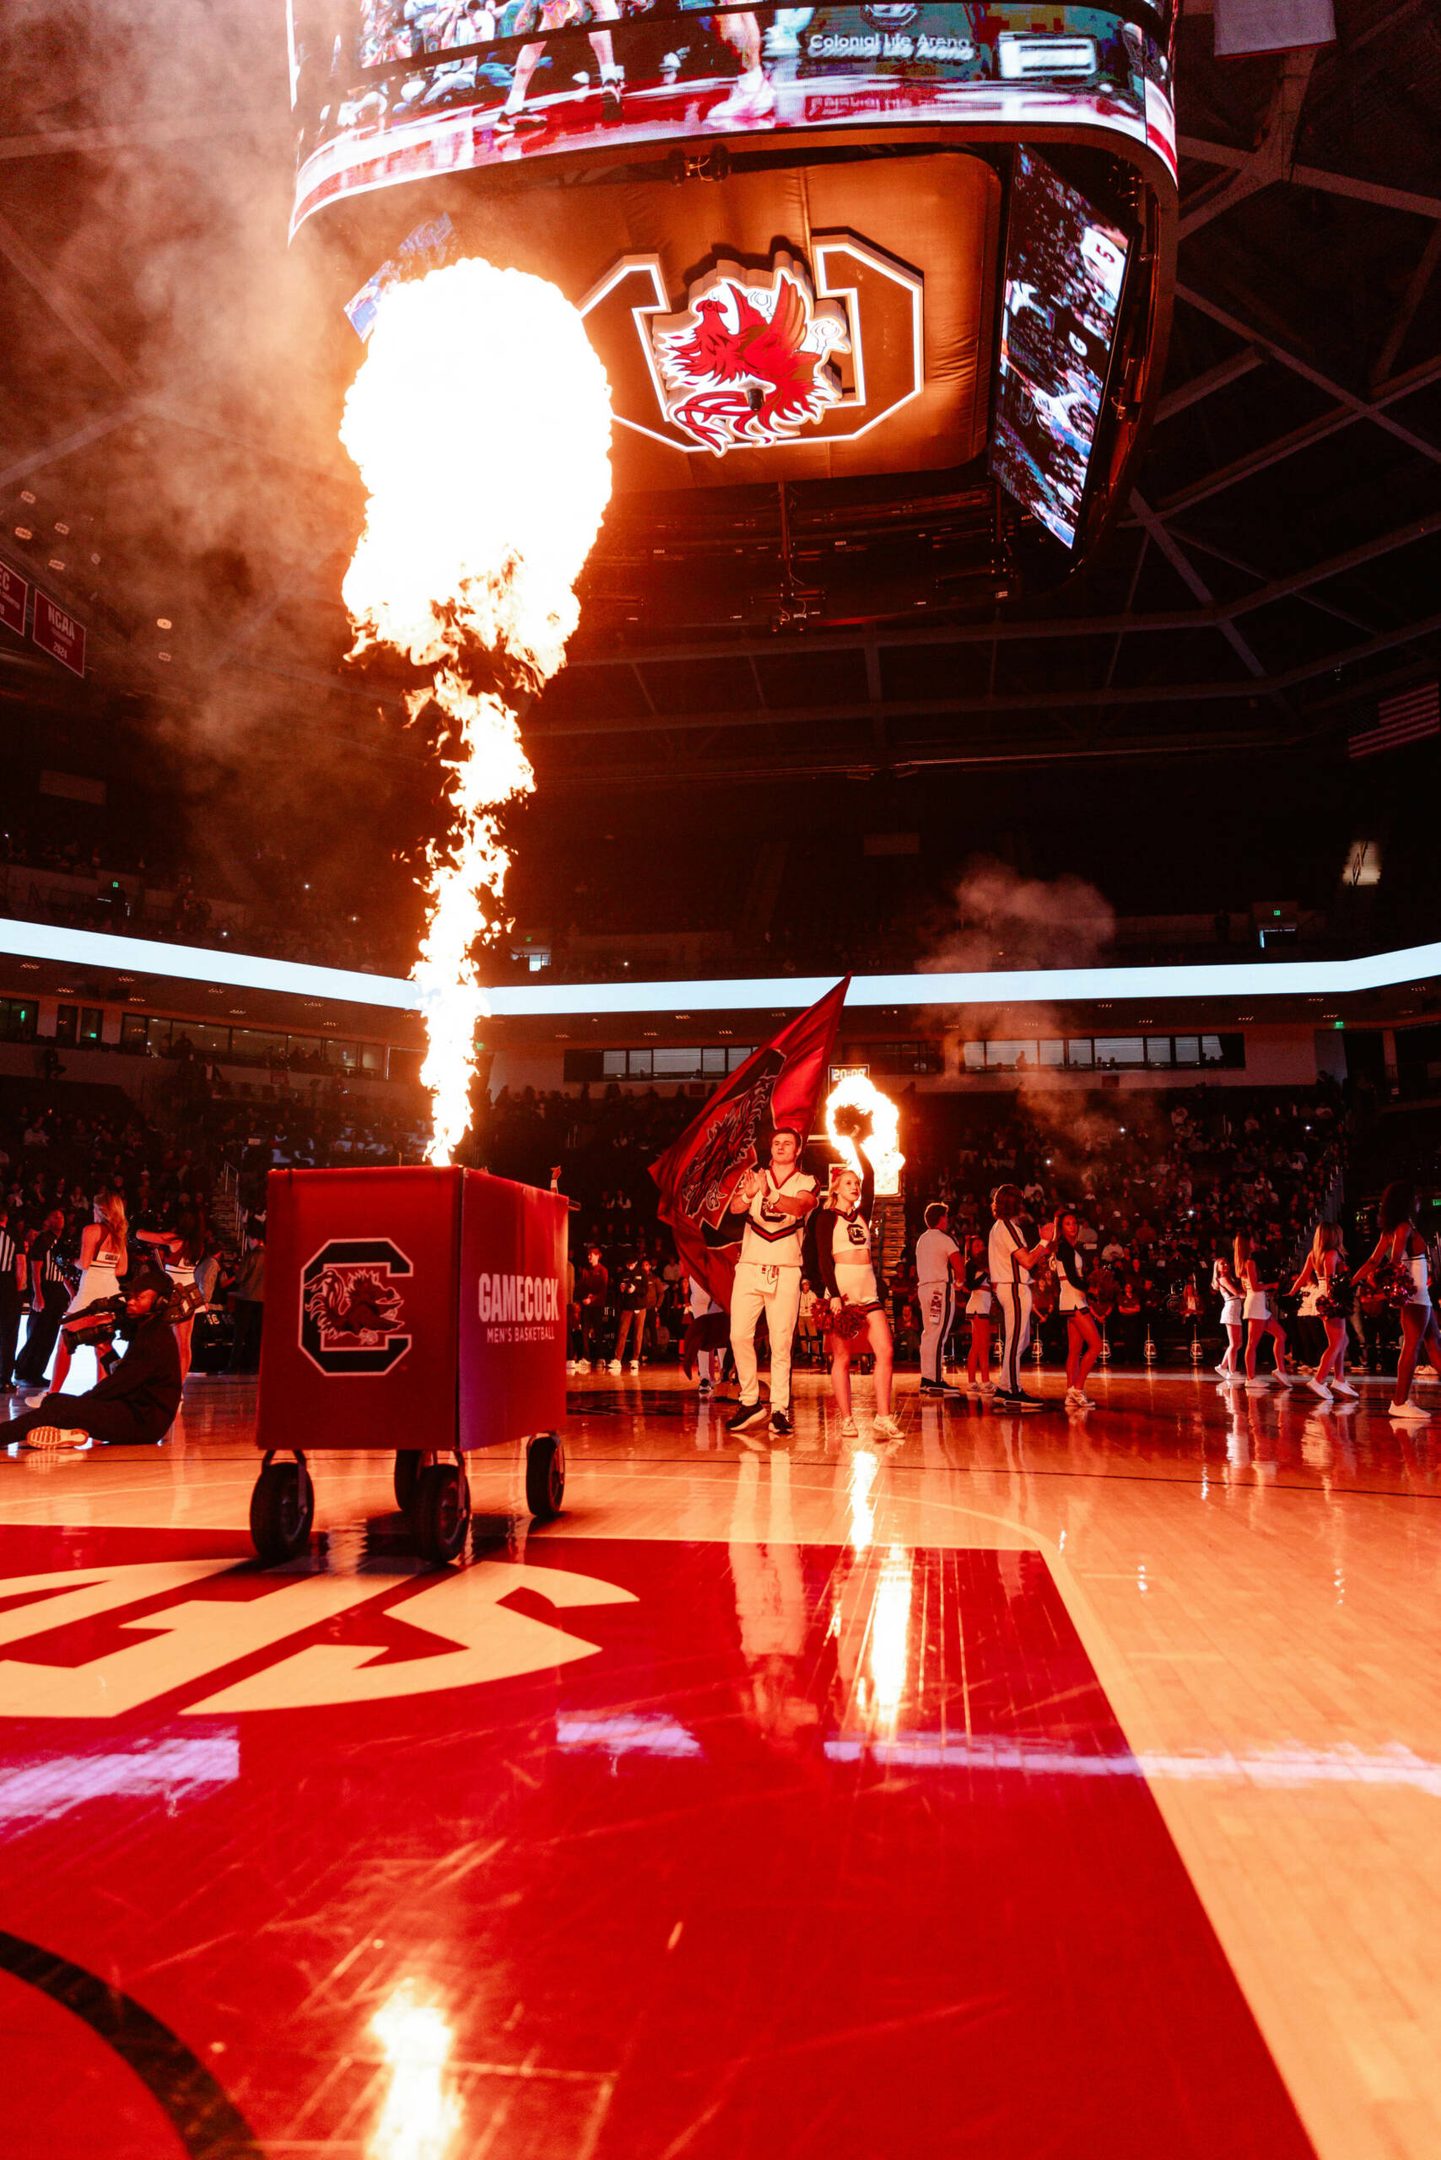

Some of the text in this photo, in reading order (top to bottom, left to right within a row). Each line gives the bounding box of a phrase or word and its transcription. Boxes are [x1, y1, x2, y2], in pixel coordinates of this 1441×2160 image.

[810, 33, 970, 49] Colonial Life Arena
[48, 604, 75, 640] NCAA
[478, 1272, 559, 1322] GAMECOCK
[486, 1326, 555, 1343] MEN'S BASKETBALL
